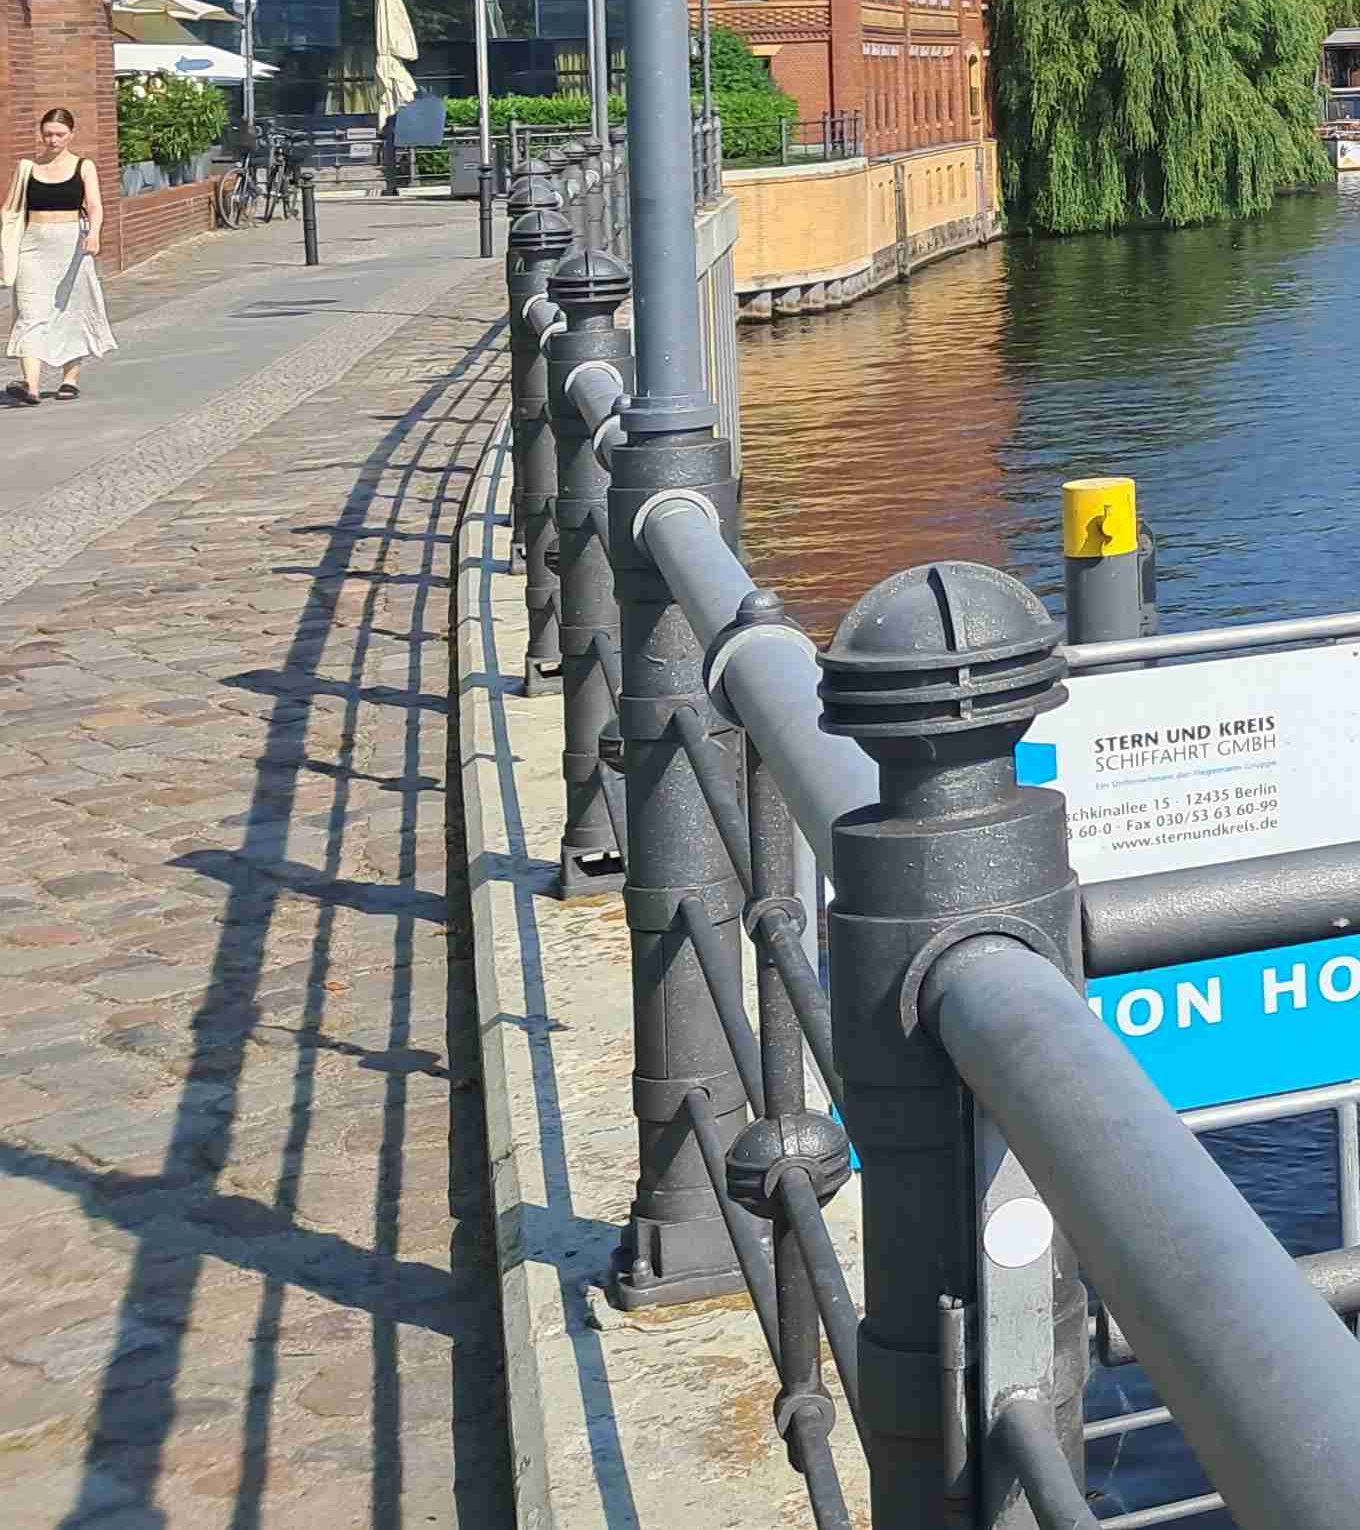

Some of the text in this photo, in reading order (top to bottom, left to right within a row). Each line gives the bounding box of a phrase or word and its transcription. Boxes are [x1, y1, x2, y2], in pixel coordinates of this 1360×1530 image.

[1094, 716, 1275, 754] STERN UND KREIS
[1095, 734, 1277, 773] SCHIFFAHRT GMBH
[1154, 796, 1170, 810] 15
[1185, 787, 1229, 806] 12435
[1235, 783, 1277, 800] Berlin
[1126, 819, 1151, 832] Fax
[1156, 806, 1209, 829] 030/53
[1214, 805, 1232, 819] 63
[1236, 799, 1279, 817] 60-99
[1111, 817, 1279, 851] www.sternundkreis.de
